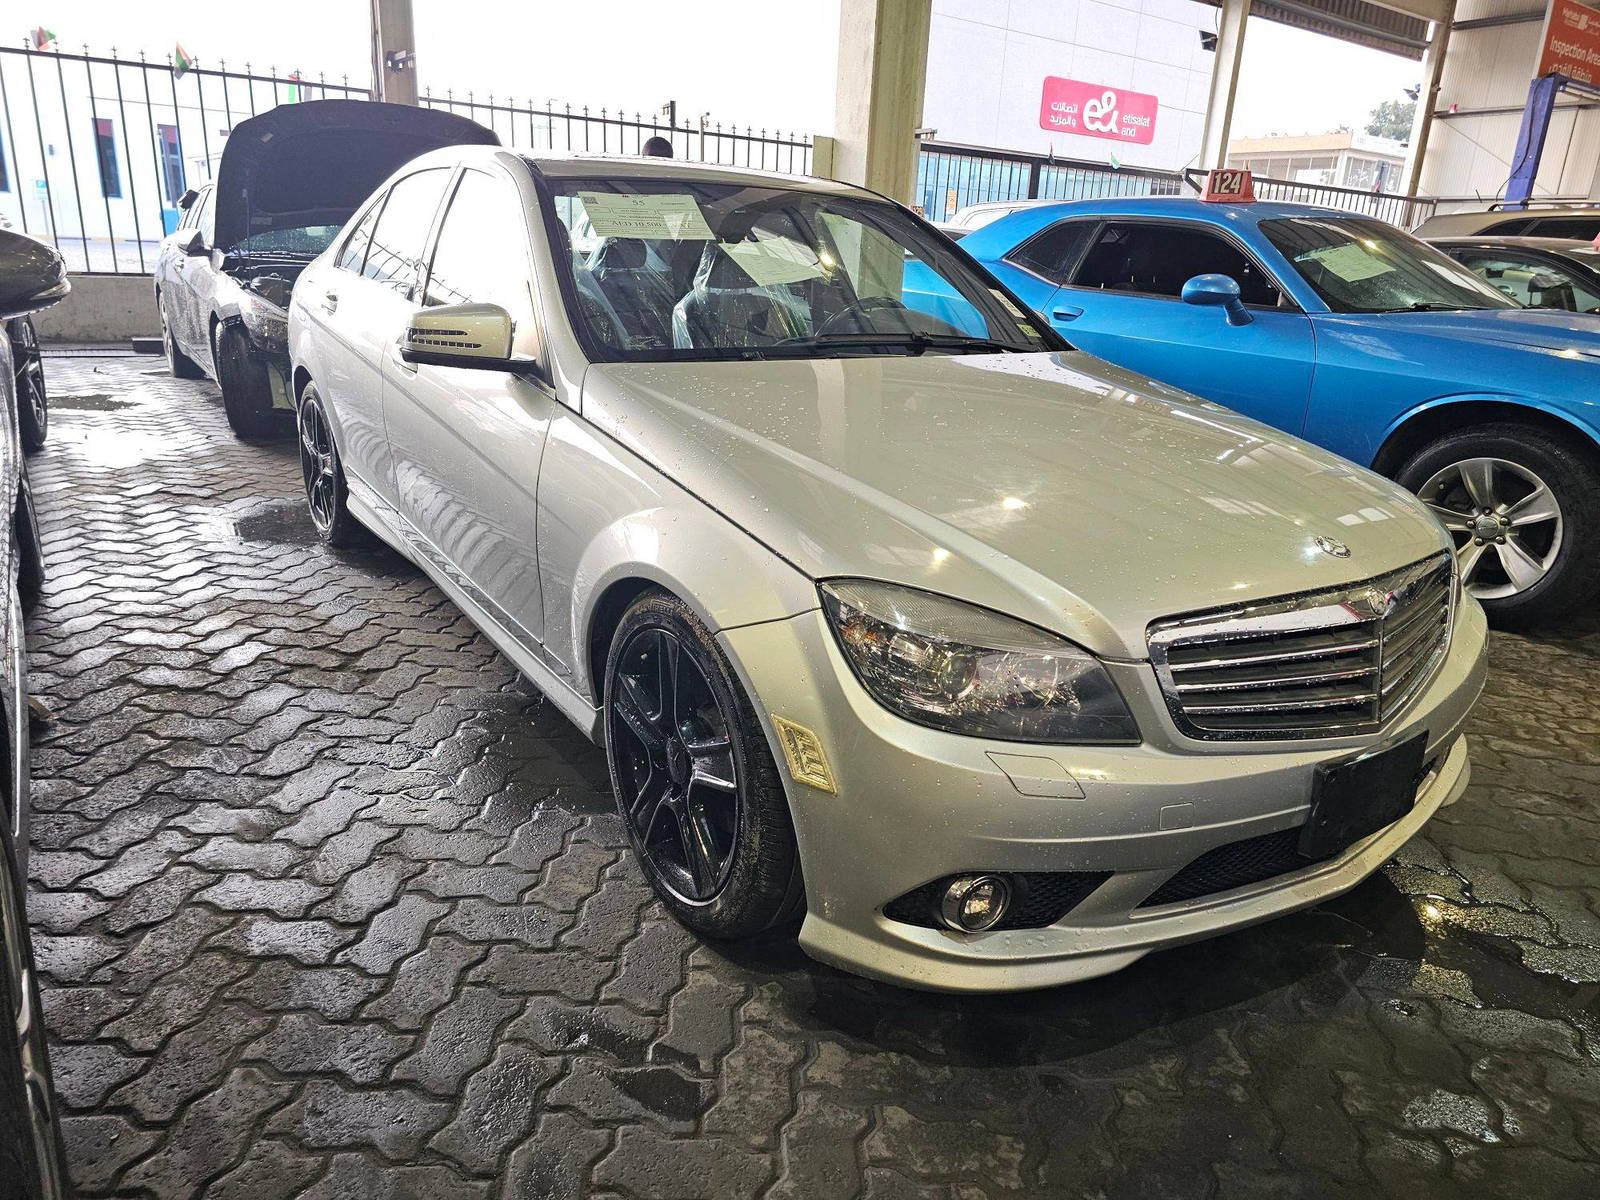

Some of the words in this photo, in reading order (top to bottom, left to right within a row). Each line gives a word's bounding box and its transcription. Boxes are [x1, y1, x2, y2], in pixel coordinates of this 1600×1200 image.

[1549, 35, 1586, 62] Inspection
[1051, 102, 1078, 112] اتصالات
[1049, 115, 1077, 127] والمزيد
[1122, 114, 1151, 127] etisalat
[1121, 126, 1137, 137] and
[1214, 172, 1242, 194] 124
